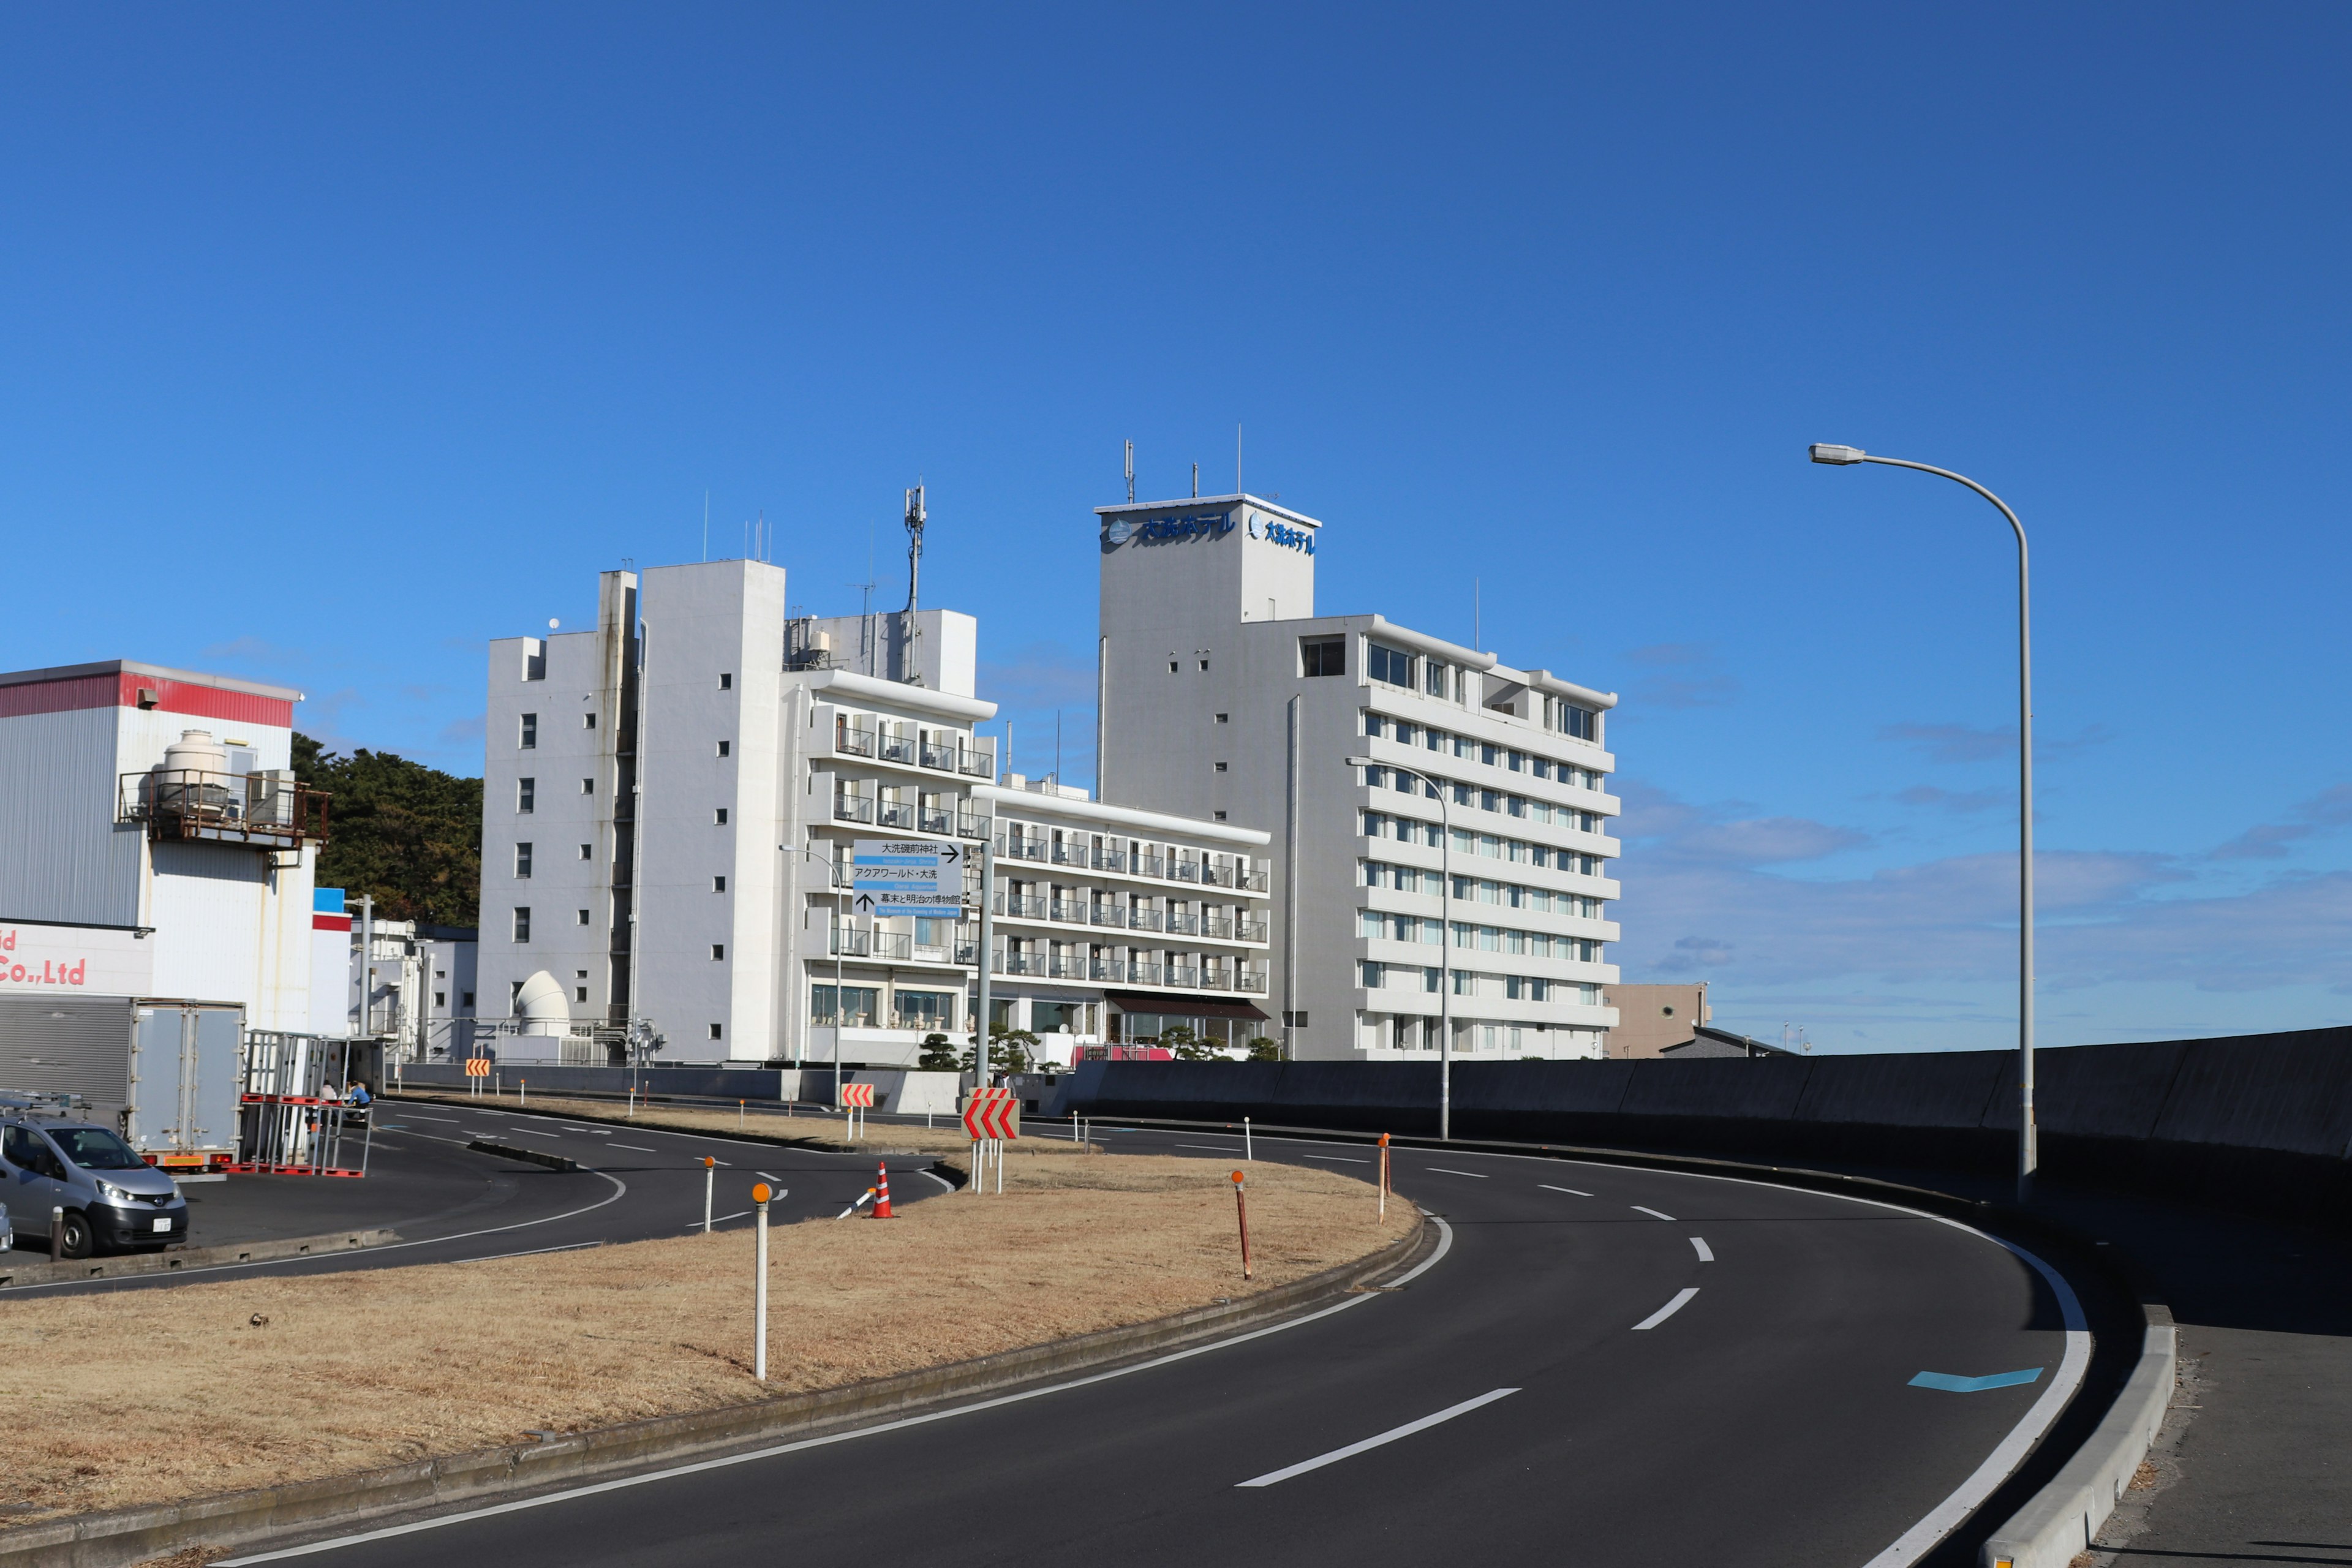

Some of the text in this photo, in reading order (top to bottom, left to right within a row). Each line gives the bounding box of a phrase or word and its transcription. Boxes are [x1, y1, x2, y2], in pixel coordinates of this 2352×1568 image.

[1142, 511, 1235, 540] 大洗ホテル
[1265, 521, 1316, 556] 大洗ホテル
[882, 843, 938, 854] 大洗磯前神社
[855, 868, 937, 879] アクアワールド・大洗
[881, 893, 960, 905] 幕末と明治の博物館
